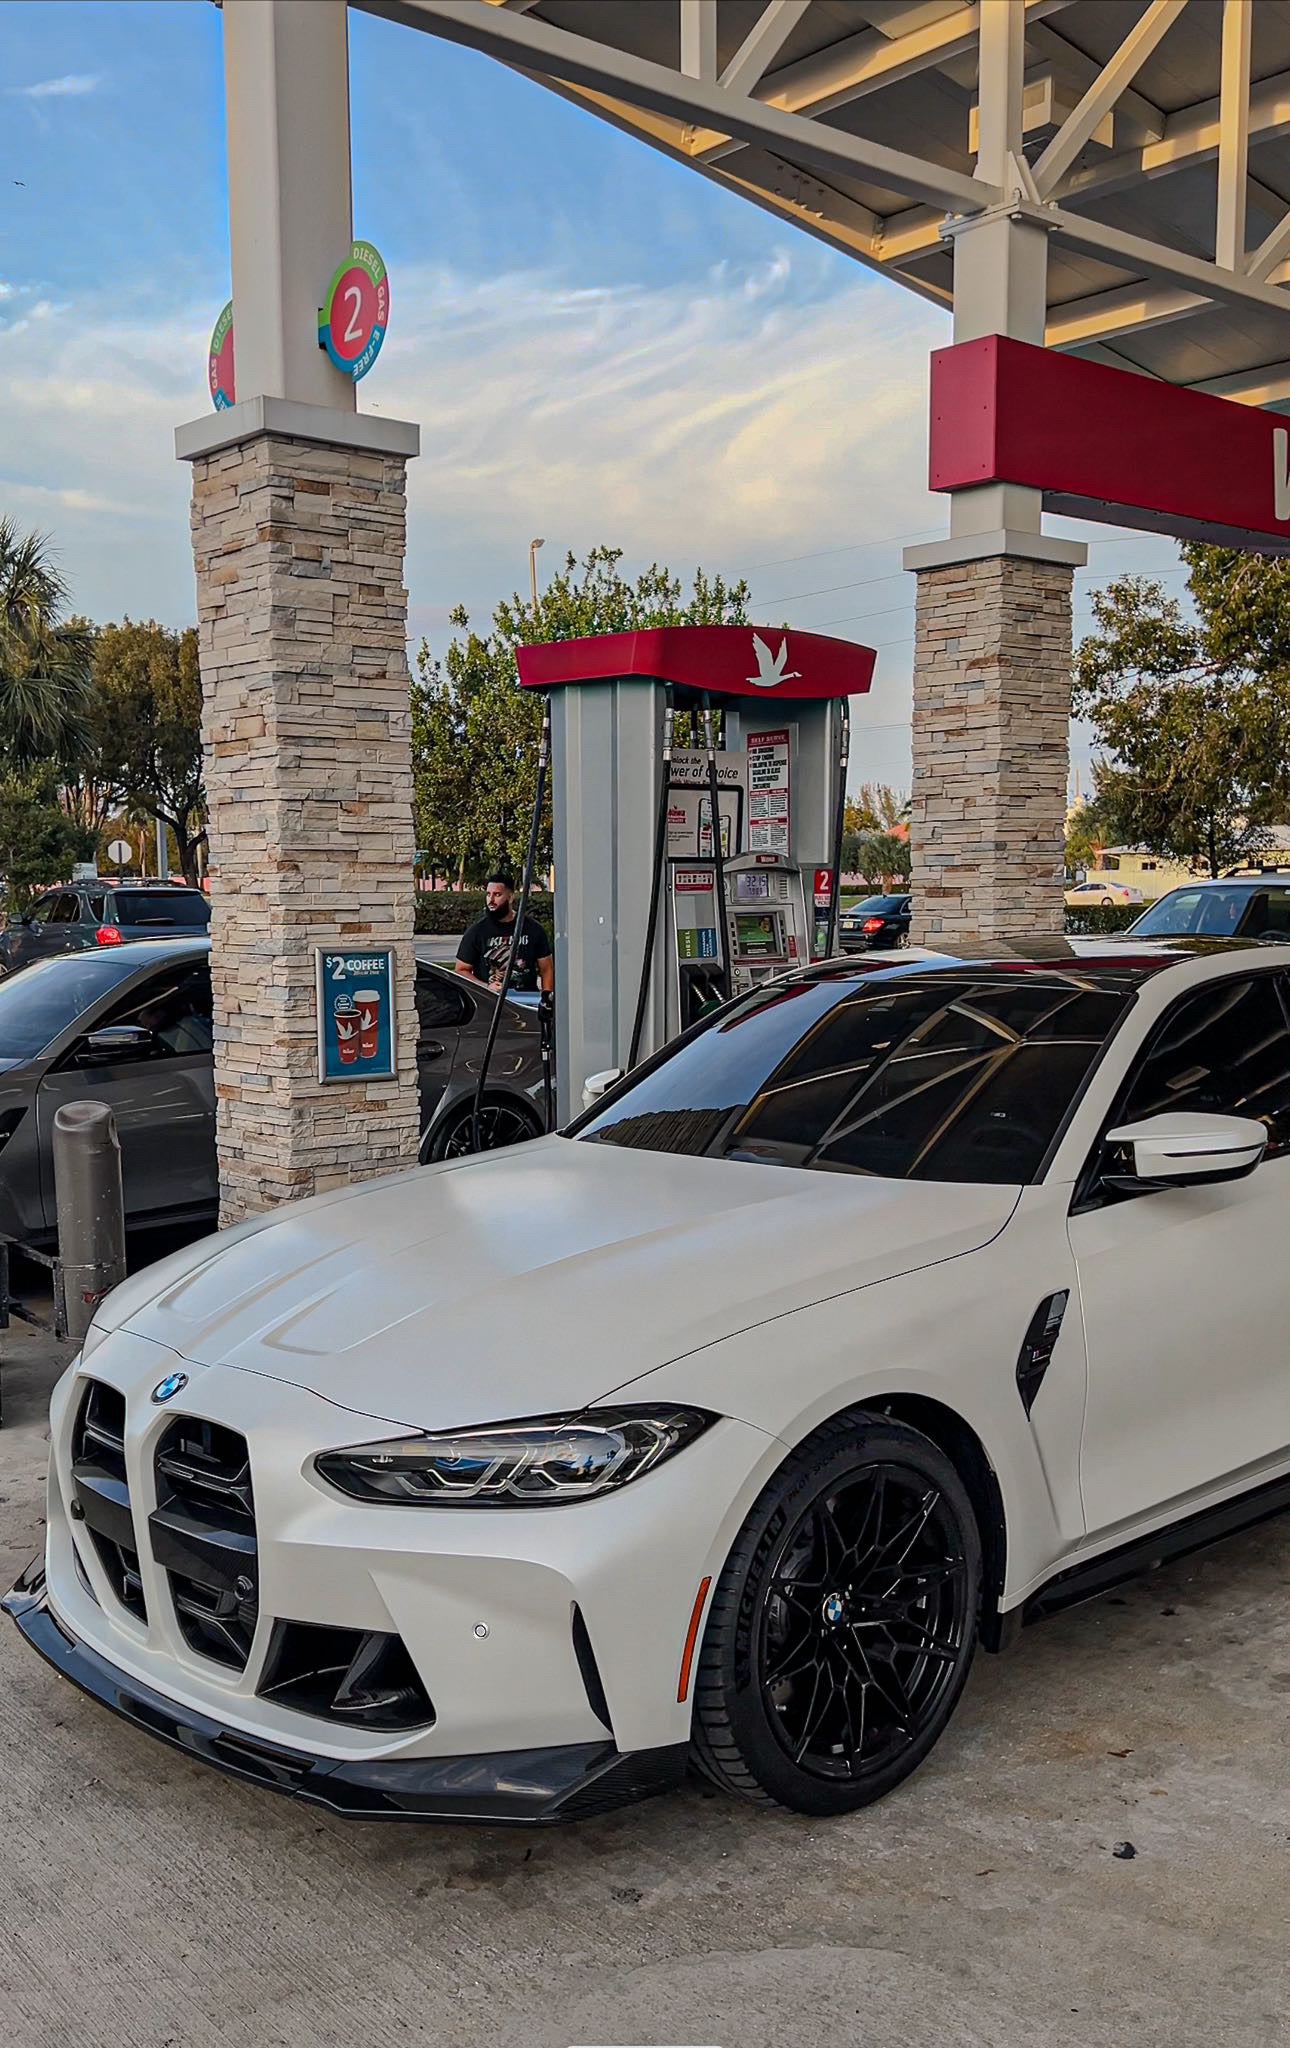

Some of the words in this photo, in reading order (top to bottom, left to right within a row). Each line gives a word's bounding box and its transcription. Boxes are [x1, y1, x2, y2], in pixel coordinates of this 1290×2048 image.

[353, 246, 381, 279] DIESEL
[343, 286, 363, 342] 2
[376, 285, 385, 321] GAS
[212, 308, 233, 349] DIESE
[353, 330, 381, 377] E-FREE
[211, 358, 219, 390] GAS
[670, 767, 691, 778] wer
[692, 764, 704, 778] of
[705, 766, 739, 779] Coice
[671, 755, 689, 765] nlock
[819, 870, 829, 891] 2
[684, 930, 692, 957] DIESEL
[326, 956, 346, 980] $2
[346, 958, 385, 971] COFFEE
[736, 1513, 784, 1651] MICHELIN
